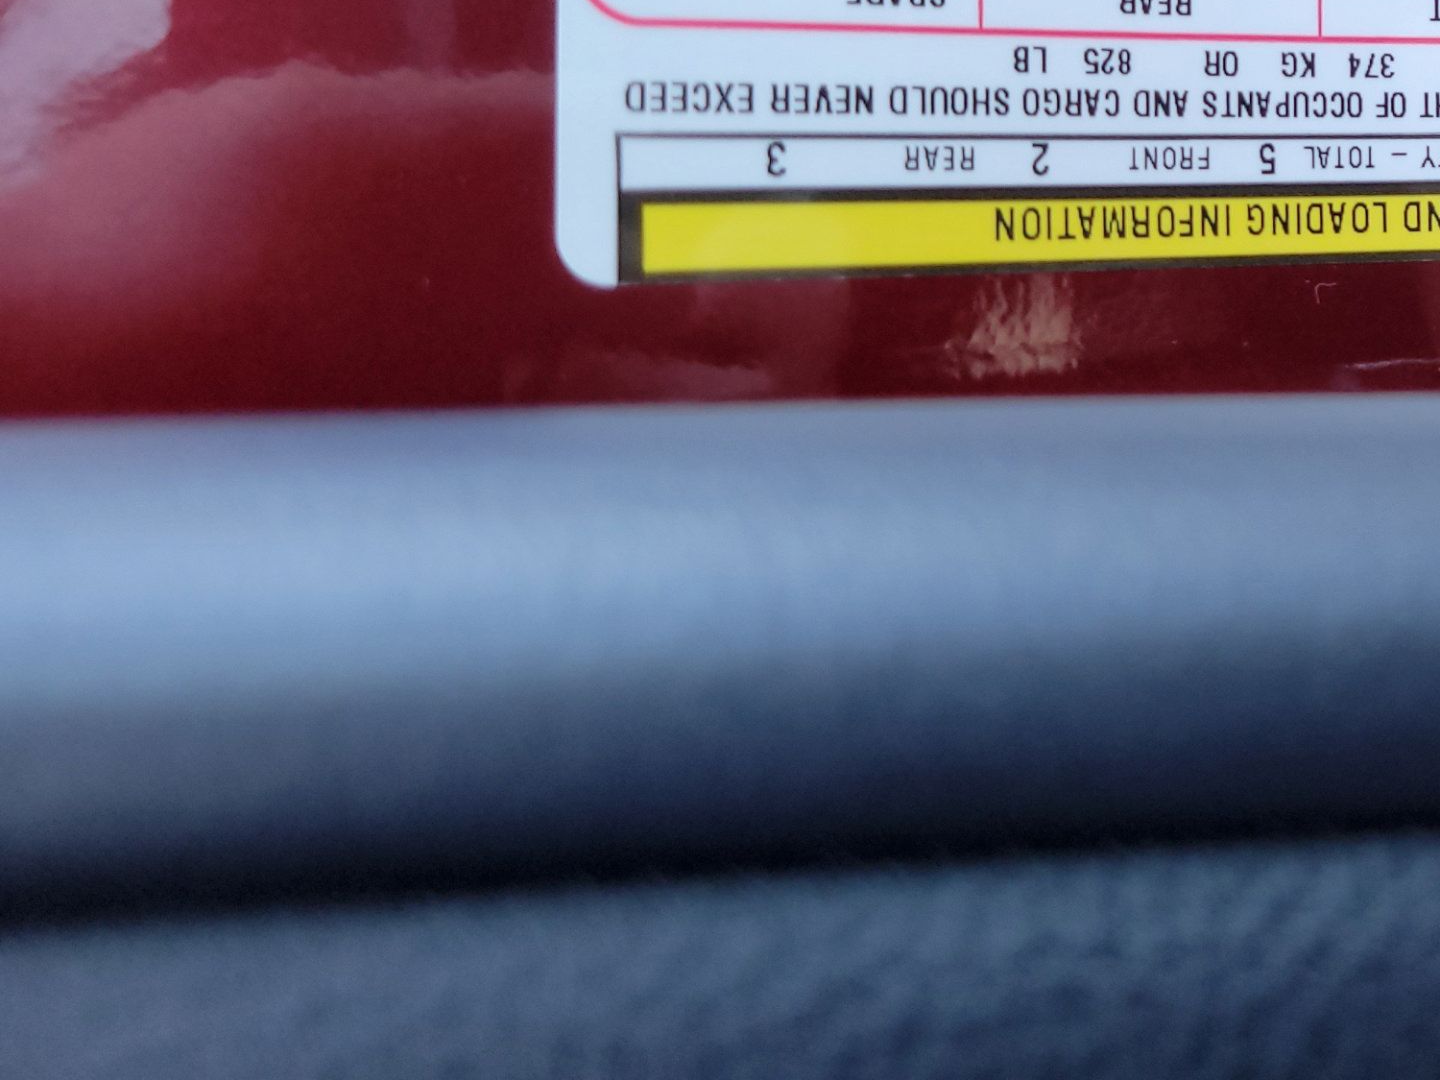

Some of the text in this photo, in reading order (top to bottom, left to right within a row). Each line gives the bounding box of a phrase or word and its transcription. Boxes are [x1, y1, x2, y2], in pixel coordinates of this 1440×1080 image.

[1013, 46, 1395, 79] 374 KG OR 825 LB
[625, 82, 754, 113] EXCEED
[770, 84, 873, 114] NEVER
[889, 86, 1010, 116] SHOULD
[1022, 88, 1120, 117] CARGO
[1133, 90, 1188, 117] AND
[1202, 90, 1363, 118] OCCUPANTS
[1376, 91, 1407, 118] OF
[767, 141, 786, 176] 3
[904, 145, 975, 171] REAR
[1031, 142, 1049, 176] 2
[1129, 146, 1210, 171] FRONT
[1259, 142, 1276, 175] 5
[1303, 145, 1375, 169] TOTAL
[995, 204, 1230, 241] INFORMATION
[1247, 201, 1387, 236] LOADING
